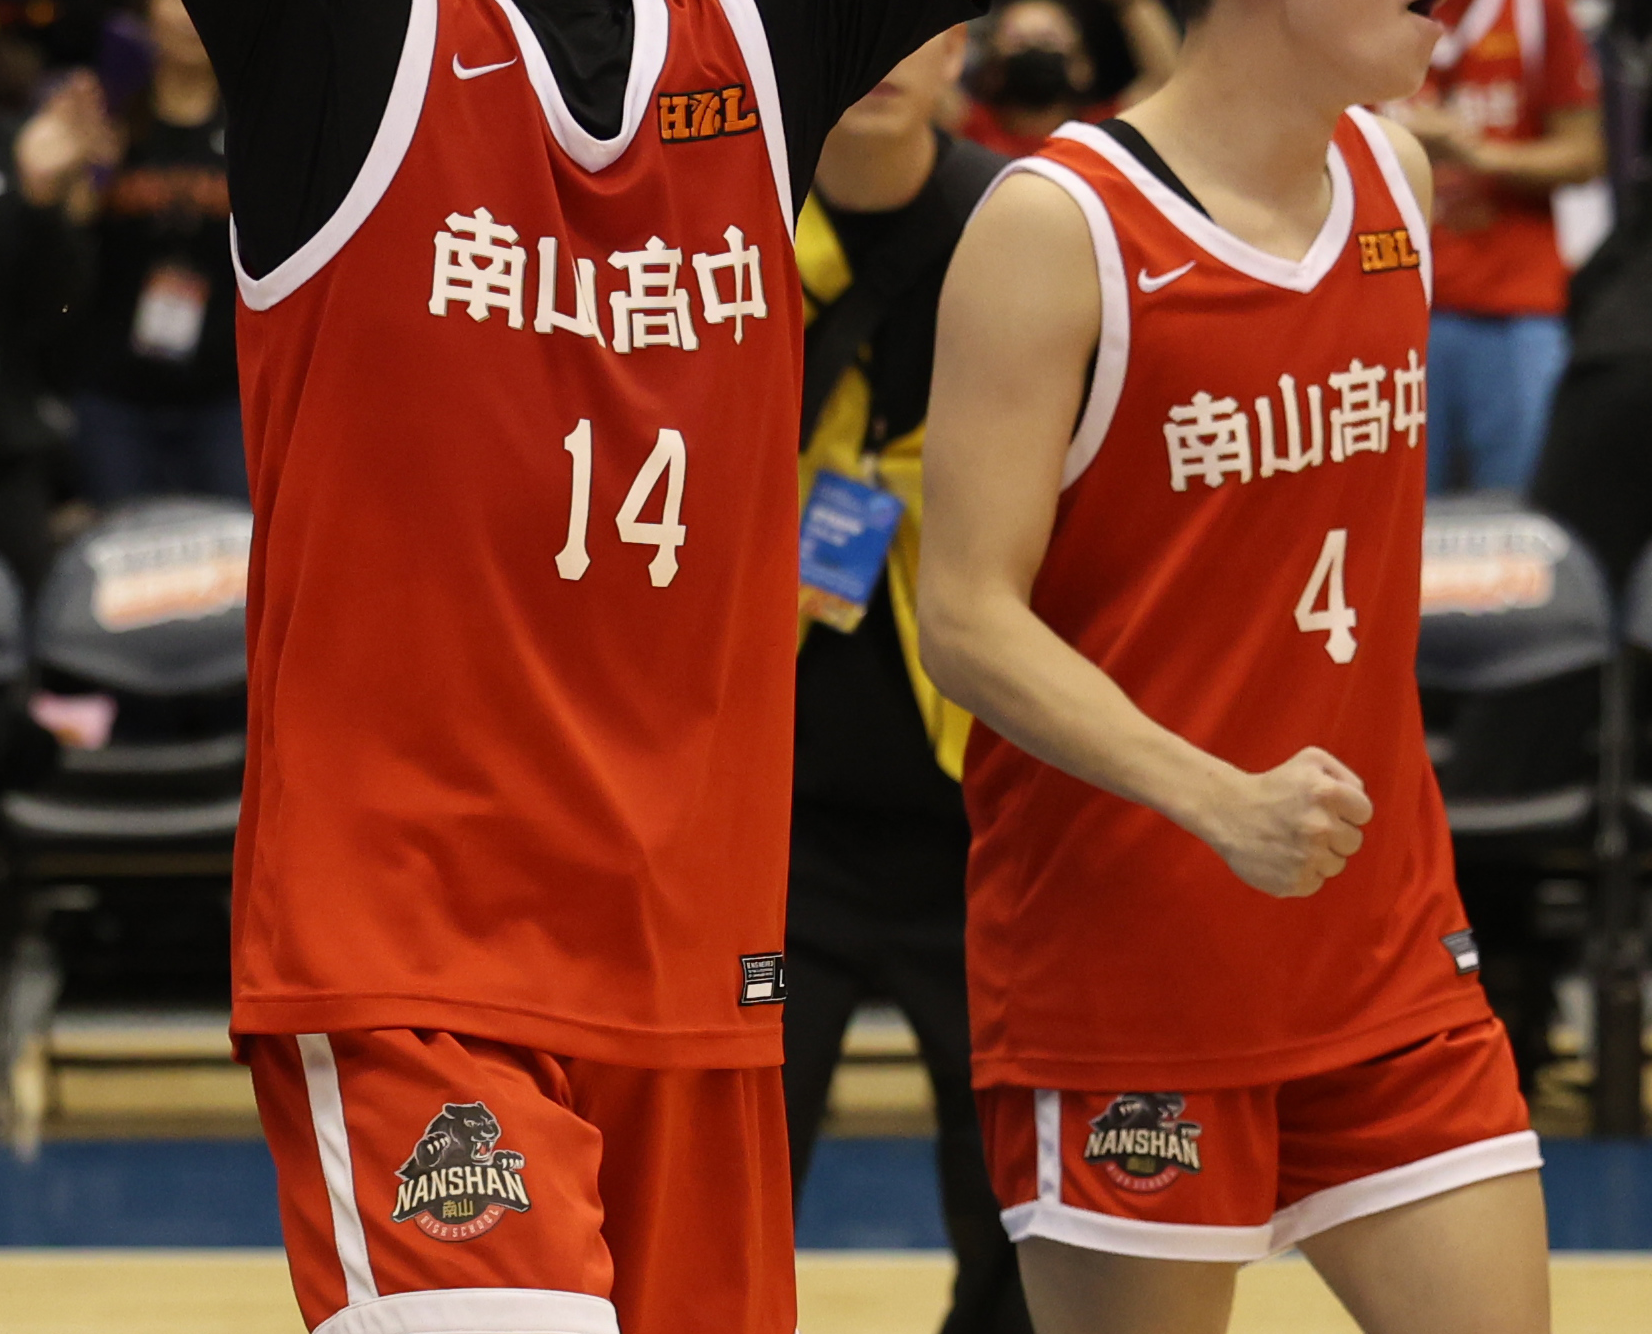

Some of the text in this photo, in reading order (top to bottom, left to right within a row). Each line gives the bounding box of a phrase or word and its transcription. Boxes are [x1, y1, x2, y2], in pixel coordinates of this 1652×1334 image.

[428, 206, 768, 354] 南山高中
[1163, 347, 1426, 492] 南山高中
[554, 418, 687, 587] 14
[1294, 528, 1357, 664] 4
[392, 1166, 530, 1217] NANSHAN
[1084, 1128, 1201, 1169] NANSHAN
